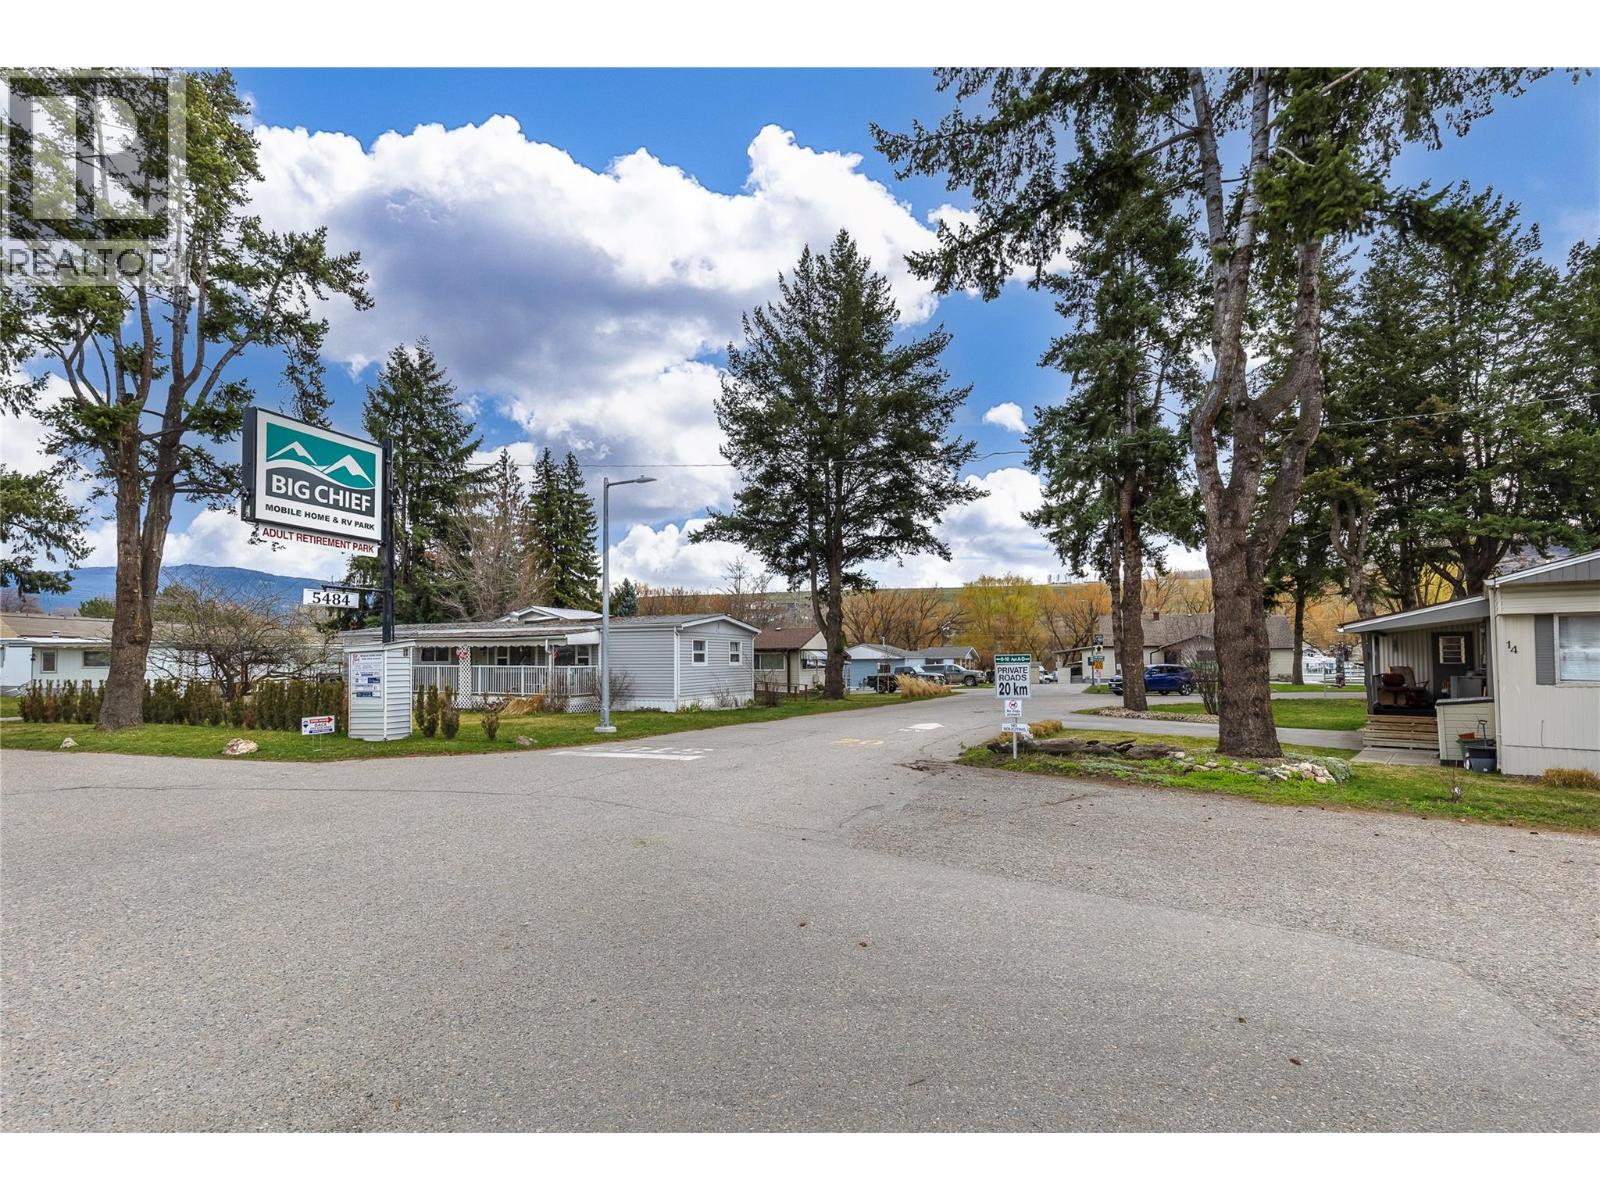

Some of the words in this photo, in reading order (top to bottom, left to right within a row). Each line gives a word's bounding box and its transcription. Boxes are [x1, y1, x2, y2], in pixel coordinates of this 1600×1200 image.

[271, 474, 310, 500] BIG
[314, 485, 371, 512] CHIEF
[265, 503, 302, 517] MOBILE
[304, 511, 330, 523] HOME
[332, 516, 339, 524] &
[341, 518, 353, 527] RV
[354, 520, 375, 531] PARK
[262, 527, 295, 541] ADULT
[296, 532, 352, 551] RETIREMENT
[352, 542, 375, 554] PARK
[312, 591, 351, 606] 5484
[1505, 640, 1518, 654] 14
[997, 666, 1029, 674] PRIVATE
[998, 674, 1027, 682] ROADS
[998, 682, 1011, 696] 20
[1013, 682, 1028, 696] km
